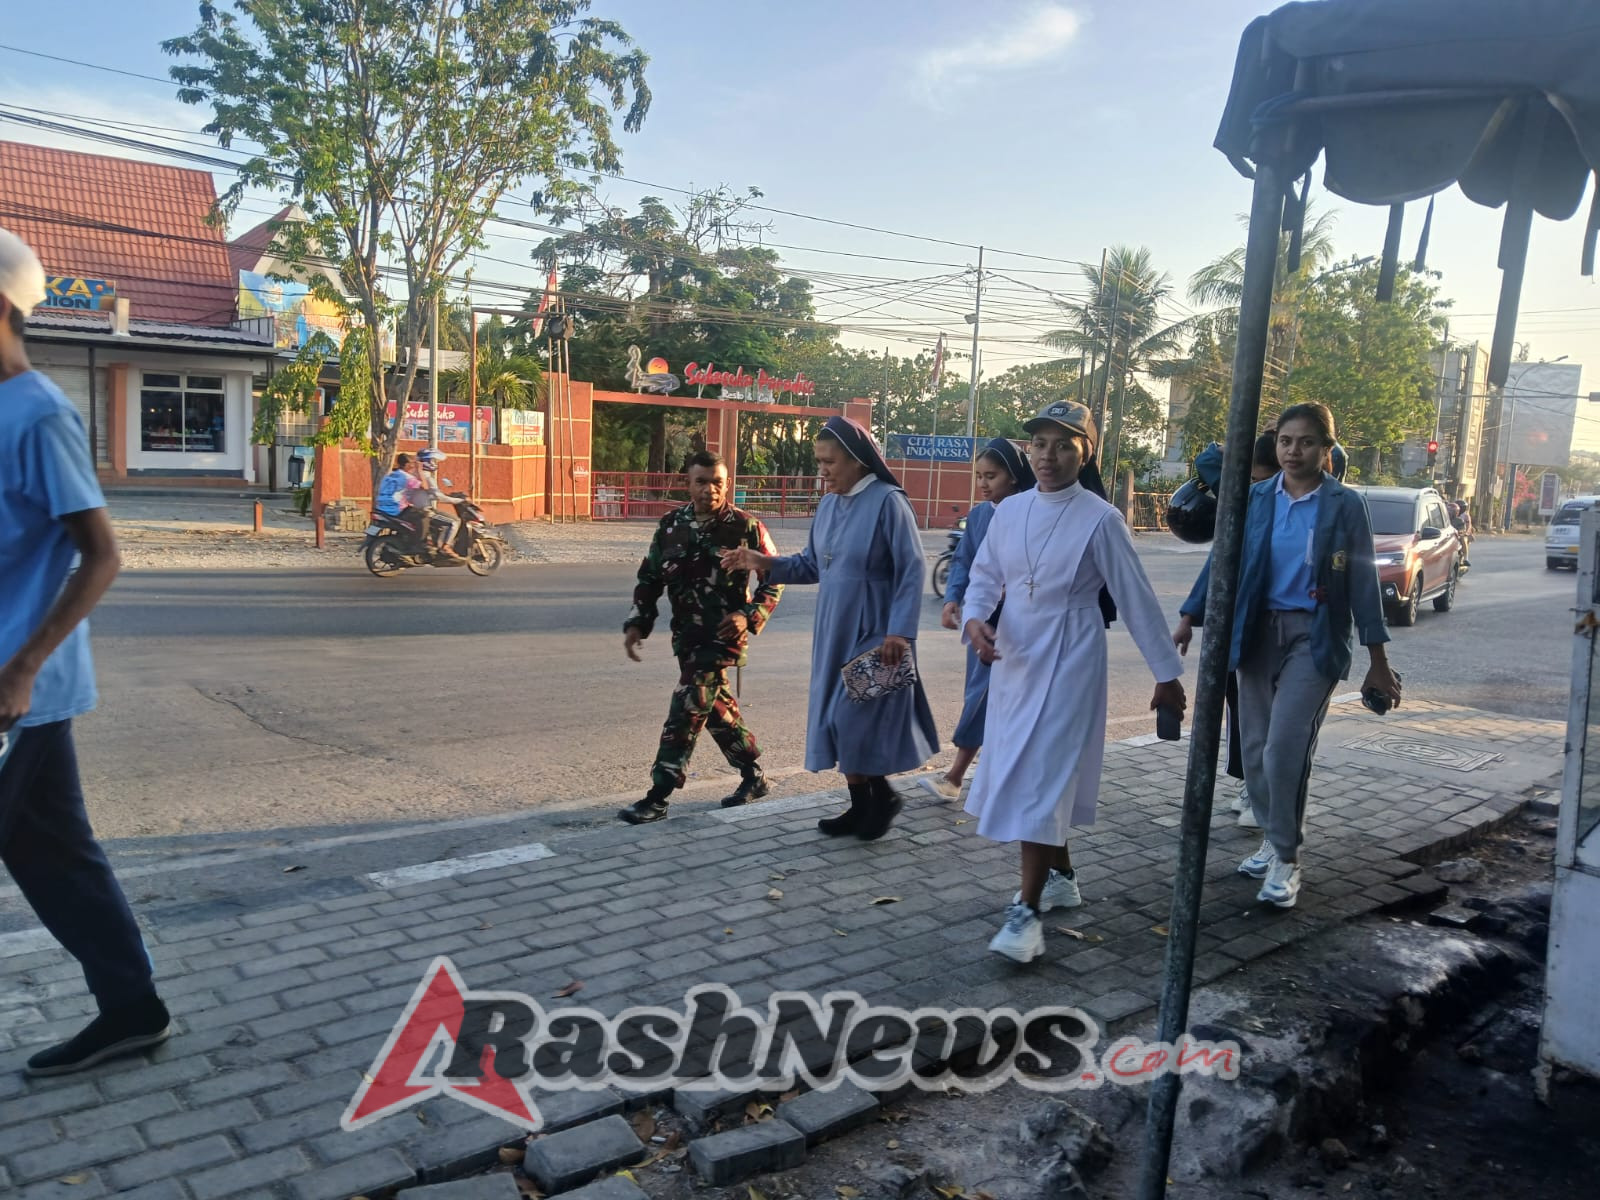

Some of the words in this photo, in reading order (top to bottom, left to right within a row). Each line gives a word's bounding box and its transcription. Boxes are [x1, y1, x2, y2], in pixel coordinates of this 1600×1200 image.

[907, 436, 934, 447] CITA
[937, 437, 970, 449] RASA
[906, 446, 970, 458] INDONESIA
